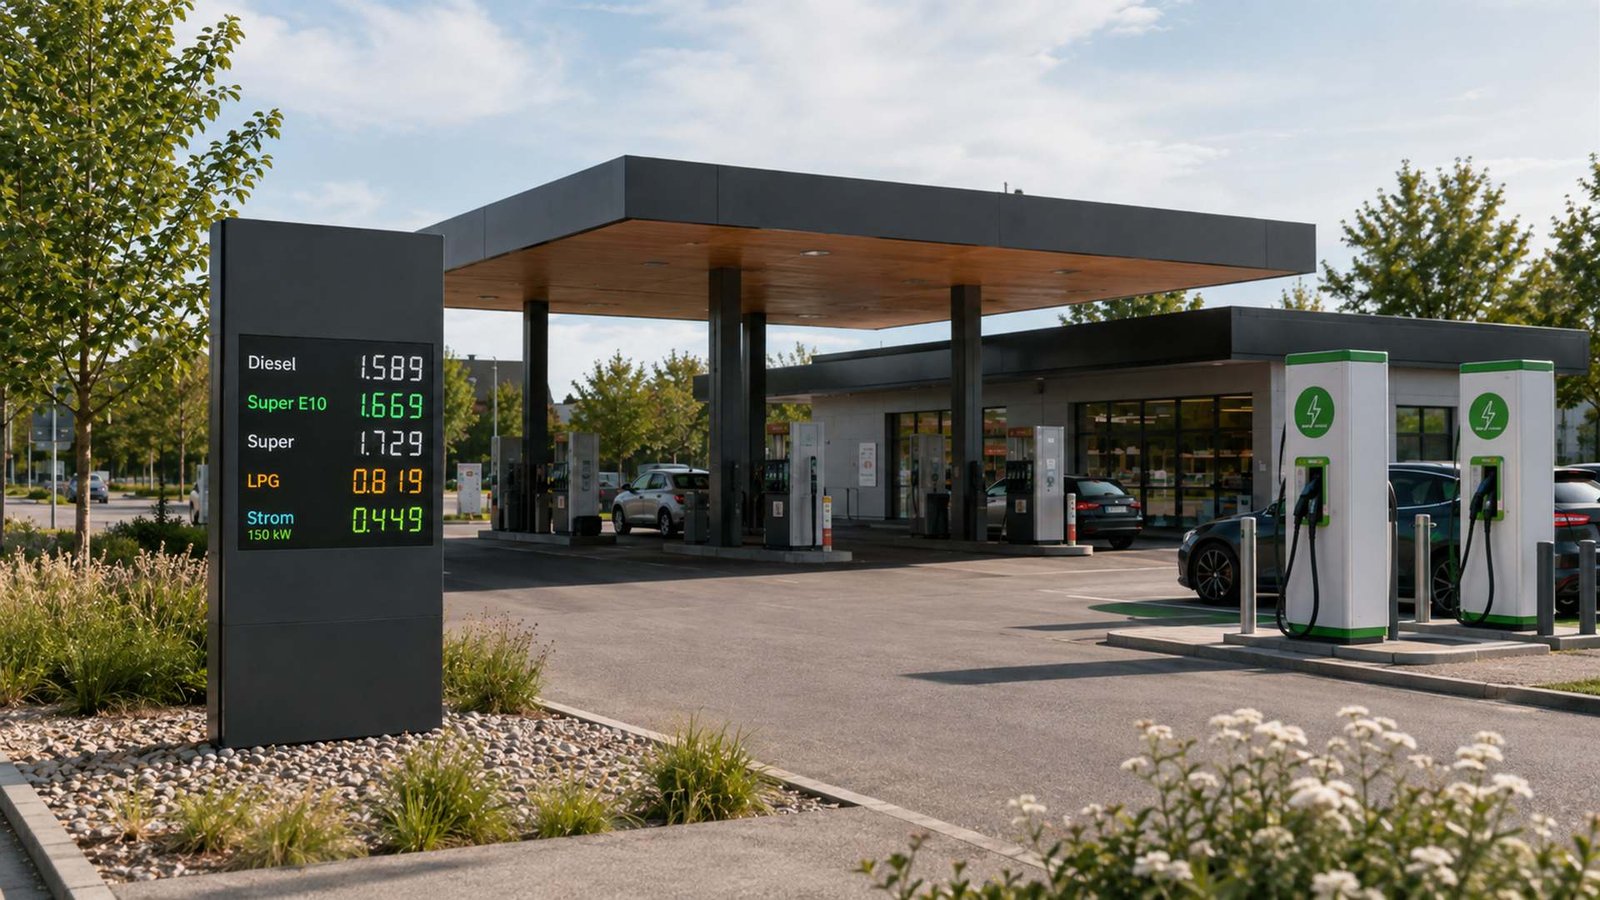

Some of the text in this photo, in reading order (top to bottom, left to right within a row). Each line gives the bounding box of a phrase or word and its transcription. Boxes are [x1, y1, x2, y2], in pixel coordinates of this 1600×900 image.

[248, 354, 423, 381] Diesel 1.589
[248, 392, 423, 419] Super E10 1.669
[248, 430, 423, 456] Super 1.729
[247, 468, 423, 494] LPG 0.819
[247, 506, 423, 533] Strom 0.449
[247, 528, 292, 540] 150 kW
